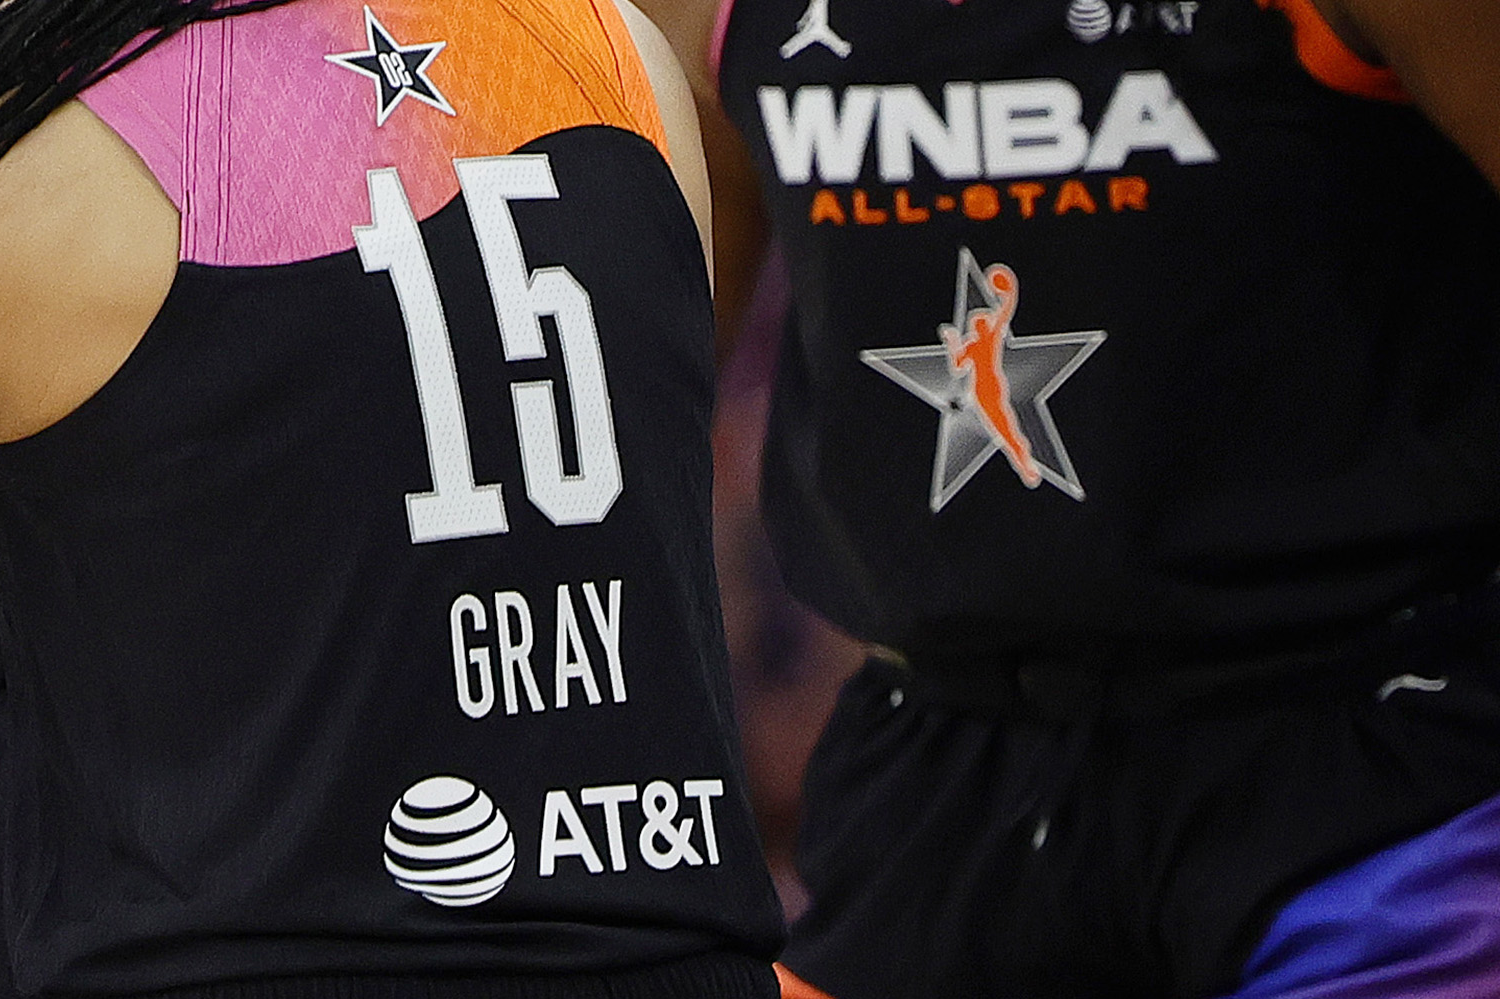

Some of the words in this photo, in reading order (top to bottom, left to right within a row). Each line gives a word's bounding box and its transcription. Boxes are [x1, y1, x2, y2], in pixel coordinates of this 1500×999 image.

[378, 51, 414, 88] 02
[756, 70, 1221, 184] WNBA
[809, 177, 1149, 225] ALL-STAR
[352, 153, 624, 544] 15
[450, 579, 627, 719] GRAY
[539, 779, 724, 877] AT&T
